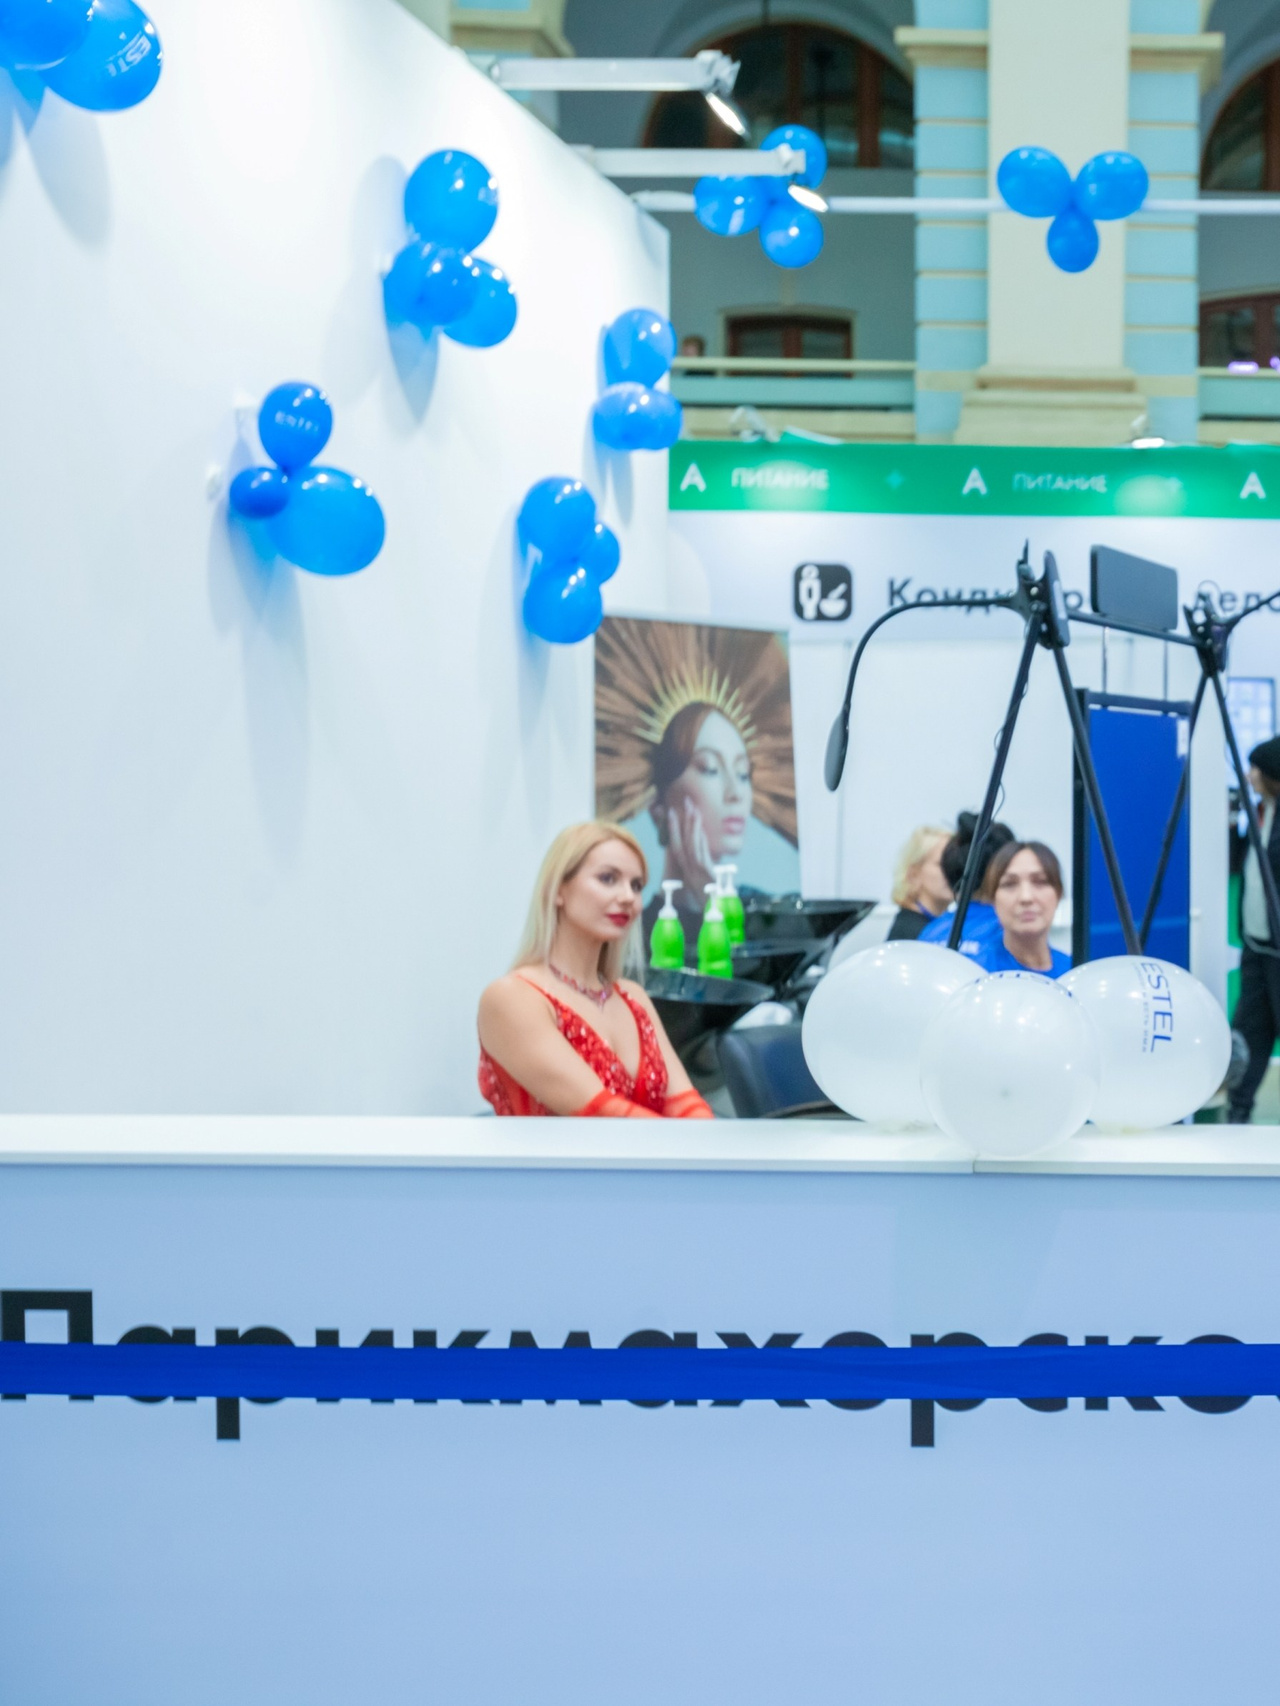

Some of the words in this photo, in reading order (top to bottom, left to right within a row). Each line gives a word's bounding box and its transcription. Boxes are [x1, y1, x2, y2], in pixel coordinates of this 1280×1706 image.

[731, 466, 829, 490] ПИТАНИЕ
[1012, 473, 1107, 493] ПИТАНИЕ
[1140, 962, 1174, 1053] ESTEL
